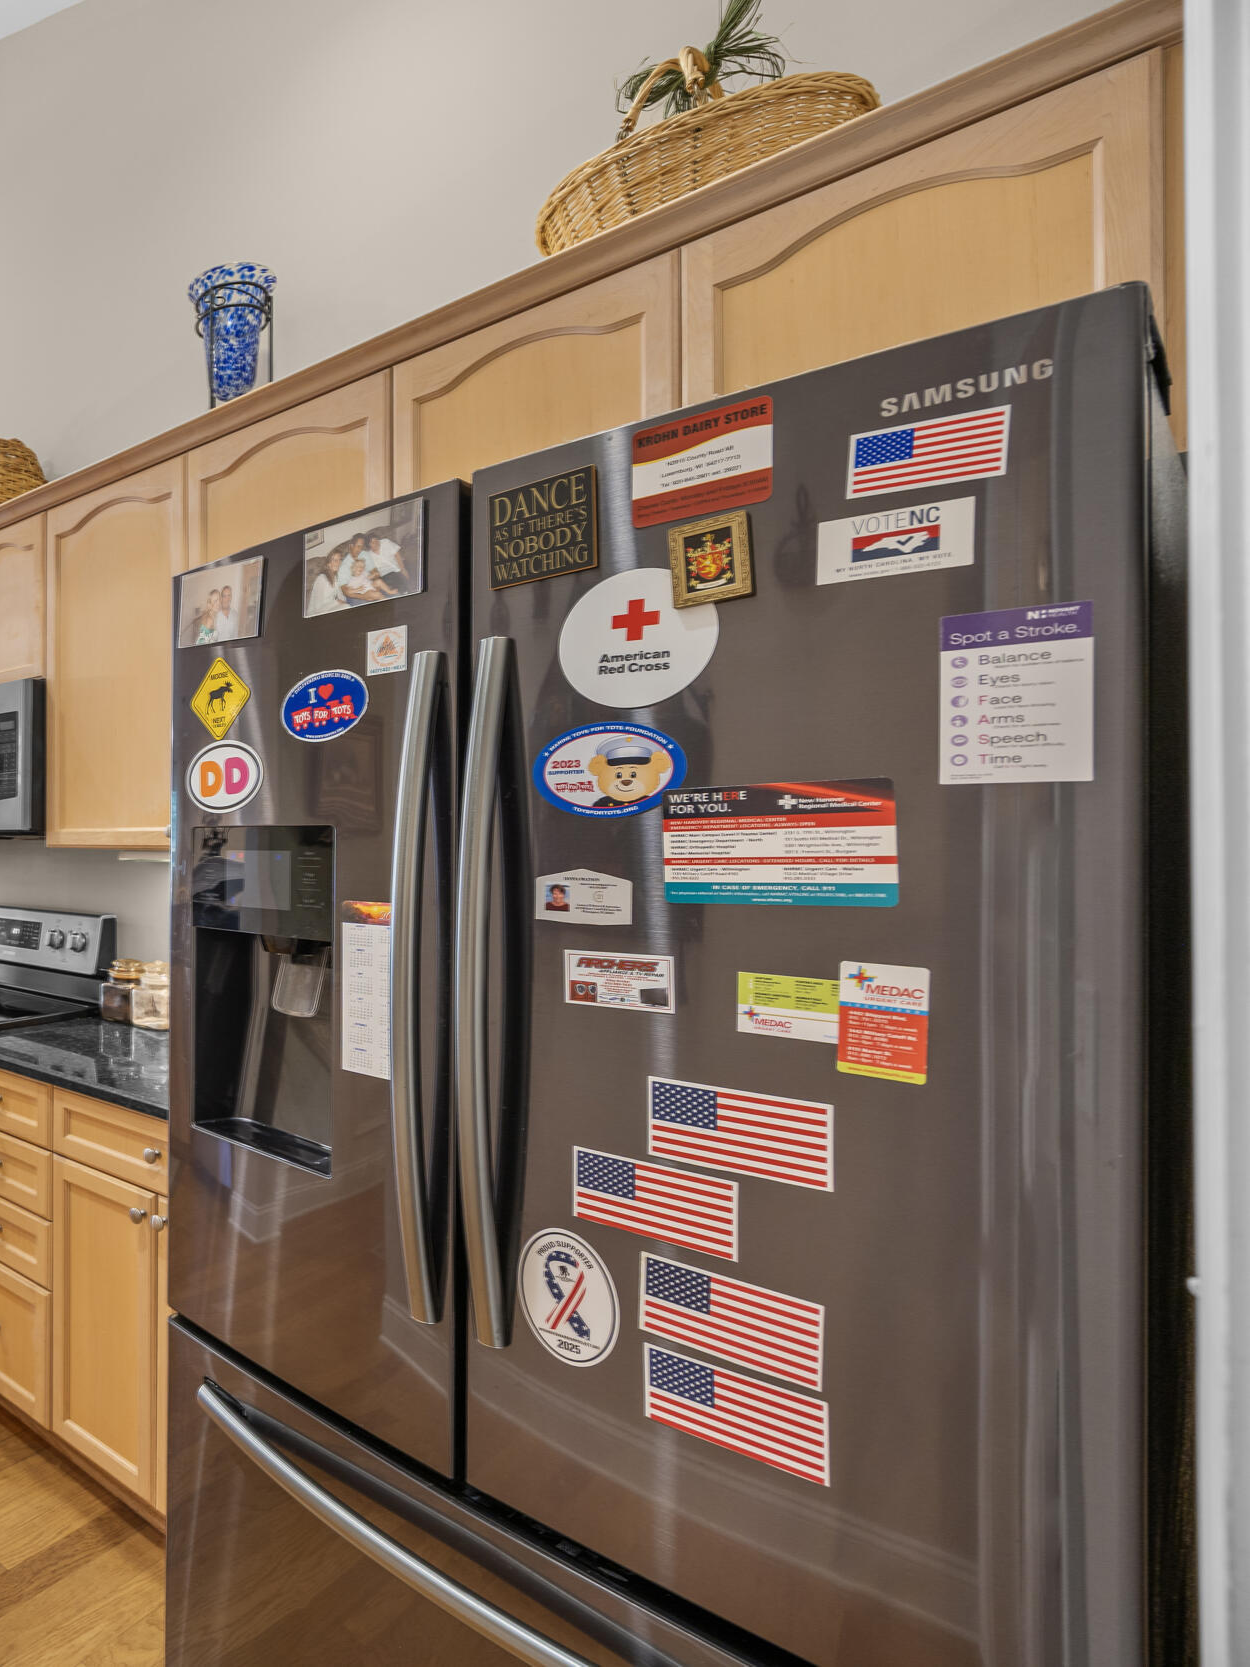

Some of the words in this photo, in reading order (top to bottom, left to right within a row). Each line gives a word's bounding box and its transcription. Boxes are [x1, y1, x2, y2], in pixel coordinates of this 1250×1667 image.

[880, 358, 1053, 417] SAMSUNG
[637, 428, 679, 448] KROHN
[682, 416, 721, 437] DAIRY
[723, 404, 768, 424] STORE
[493, 473, 588, 527] DANCE
[494, 527, 509, 542] AS
[511, 522, 525, 537] IF
[528, 506, 588, 533] THERE'S
[494, 522, 587, 562] NOBODY
[494, 544, 589, 581] WATCHING
[950, 631, 993, 646] Spot
[998, 631, 1010, 640] a
[1014, 622, 1082, 639] Stroke.
[598, 650, 671, 664] American
[978, 650, 1052, 666] Balance
[210, 671, 229, 680] MOOSE
[597, 664, 626, 675] Red
[628, 662, 671, 673] Cross
[978, 673, 1021, 687] Eyes
[308, 687, 318, 704] I
[978, 694, 1022, 706] Face
[212, 716, 226, 724] NEXT
[294, 711, 311, 724] TOYS
[314, 710, 328, 719] FOR
[331, 704, 352, 715] TOTS
[978, 713, 1025, 725] Arms
[549, 736, 571, 752] MARINE
[572, 729, 590, 738] TOYS
[625, 726, 668, 745] FOUNDATION
[978, 732, 1048, 747] Speech
[551, 759, 581, 769] 2023
[978, 753, 1022, 764] Time
[200, 756, 250, 798] DD
[668, 792, 709, 804] WE'RE
[712, 790, 748, 801] HERE
[573, 806, 639, 815] TOYSFORTOTS.ORG
[669, 804, 695, 815] FOR
[698, 803, 732, 814] YOU.
[576, 957, 660, 972] ARCHERS
[865, 984, 926, 1000] MEDAC
[754, 1018, 792, 1029] MEDAC
[537, 1240, 556, 1257] PROUD
[556, 1240, 594, 1270] SUPPORTER
[557, 1339, 581, 1355] 2025
